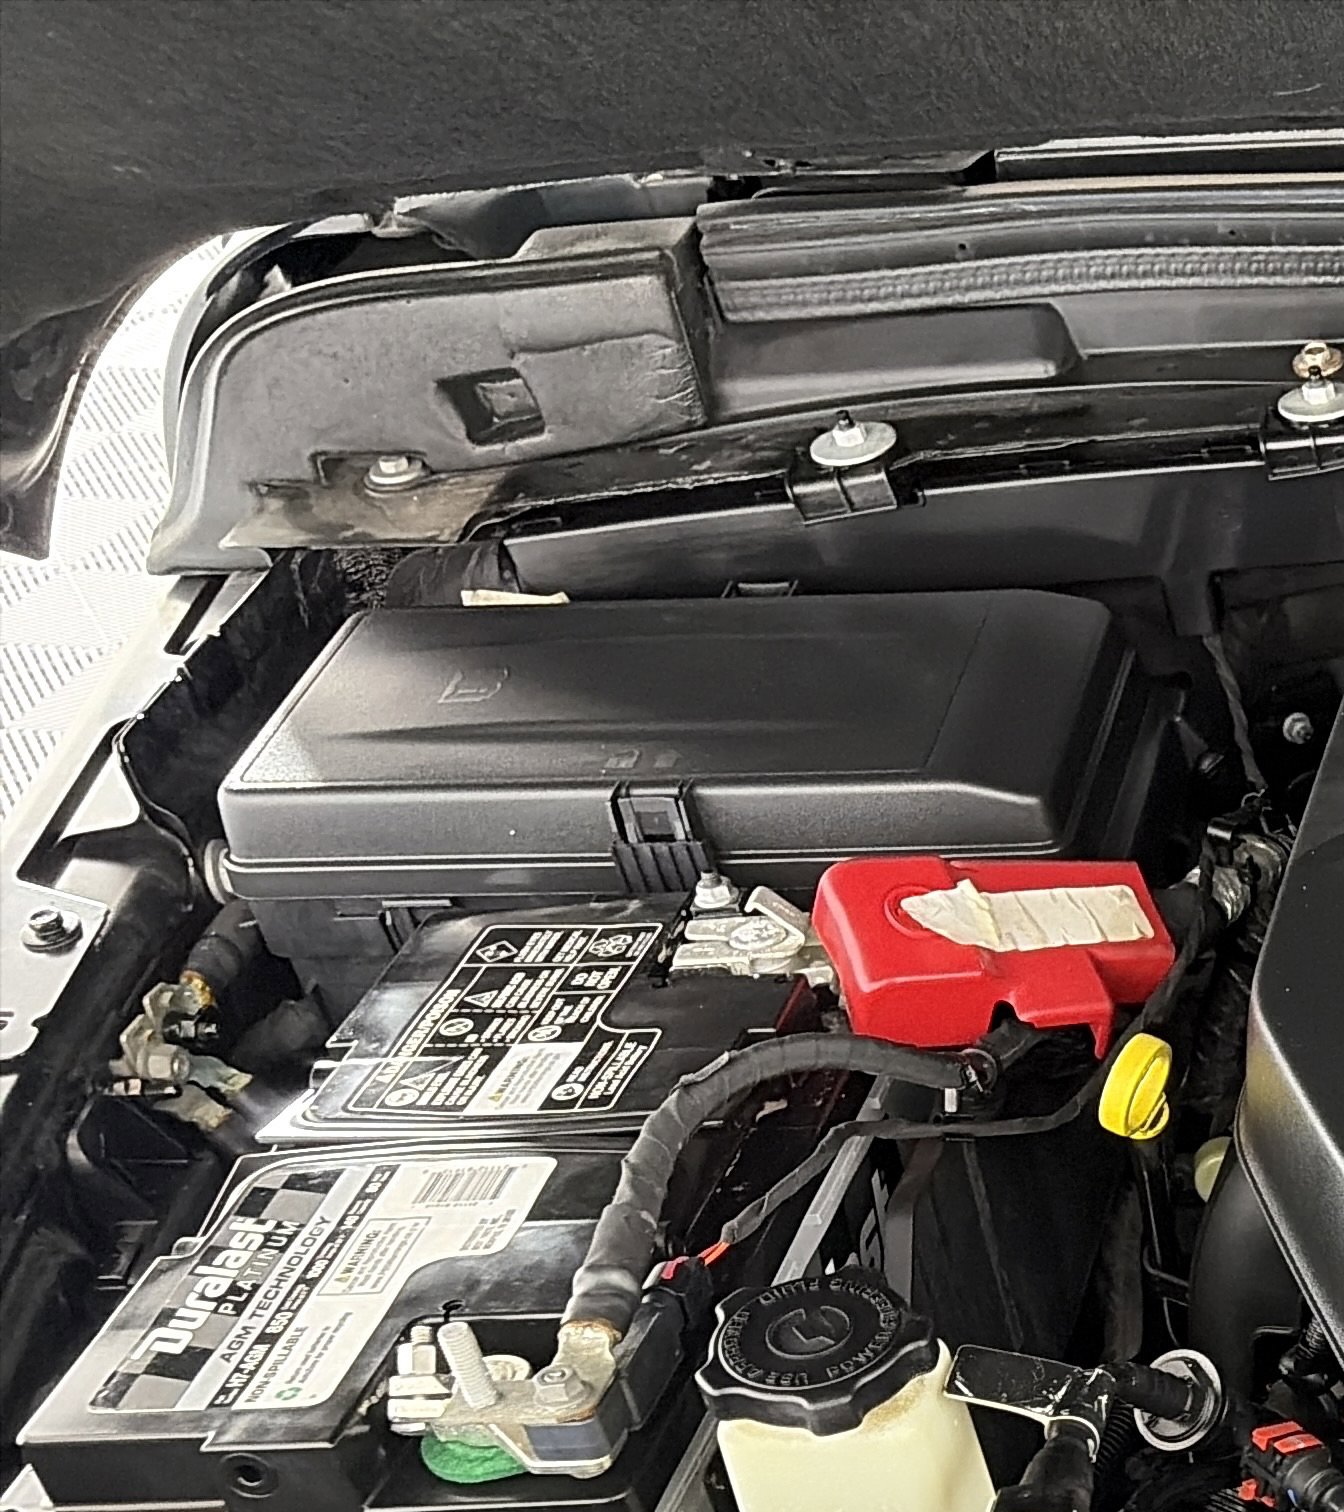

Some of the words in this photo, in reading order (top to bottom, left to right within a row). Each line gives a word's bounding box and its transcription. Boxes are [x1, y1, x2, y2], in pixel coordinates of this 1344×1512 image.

[131, 1217, 275, 1361] Duralast
[217, 1219, 301, 1316] PLATINUM
[219, 1325, 257, 1364] AGM
[248, 1215, 332, 1321] TECHNOLOGY
[759, 1278, 820, 1306] FLUID
[225, 1343, 271, 1388] H7-AGM
[265, 1311, 293, 1334] 850
[306, 1259, 329, 1279] 1000
[244, 1326, 309, 1403] NON-SPILLABLE
[766, 1372, 808, 1386] USE
